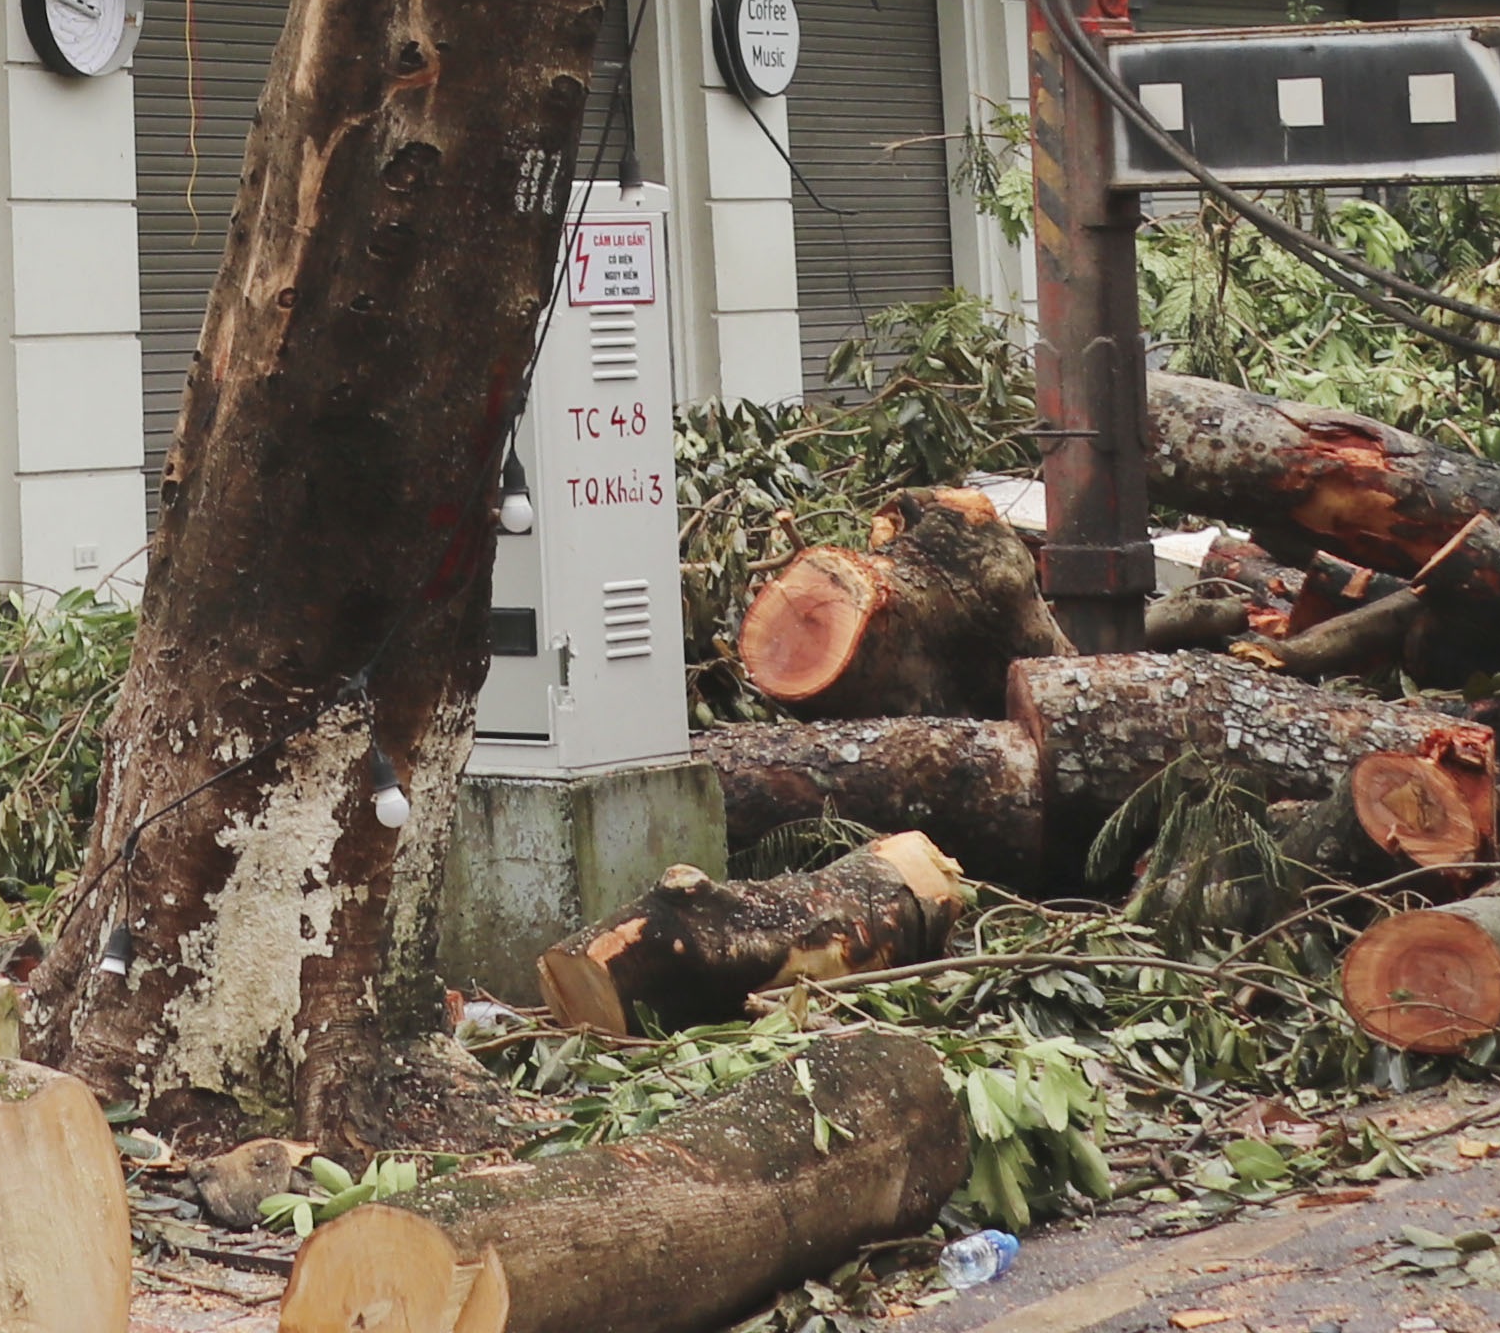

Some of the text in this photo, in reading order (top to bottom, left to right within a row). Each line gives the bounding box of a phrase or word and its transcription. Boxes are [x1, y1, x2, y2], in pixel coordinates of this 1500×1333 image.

[752, 45, 786, 68] Music
[568, 408, 600, 440] TC
[649, 474, 663, 505] 3
